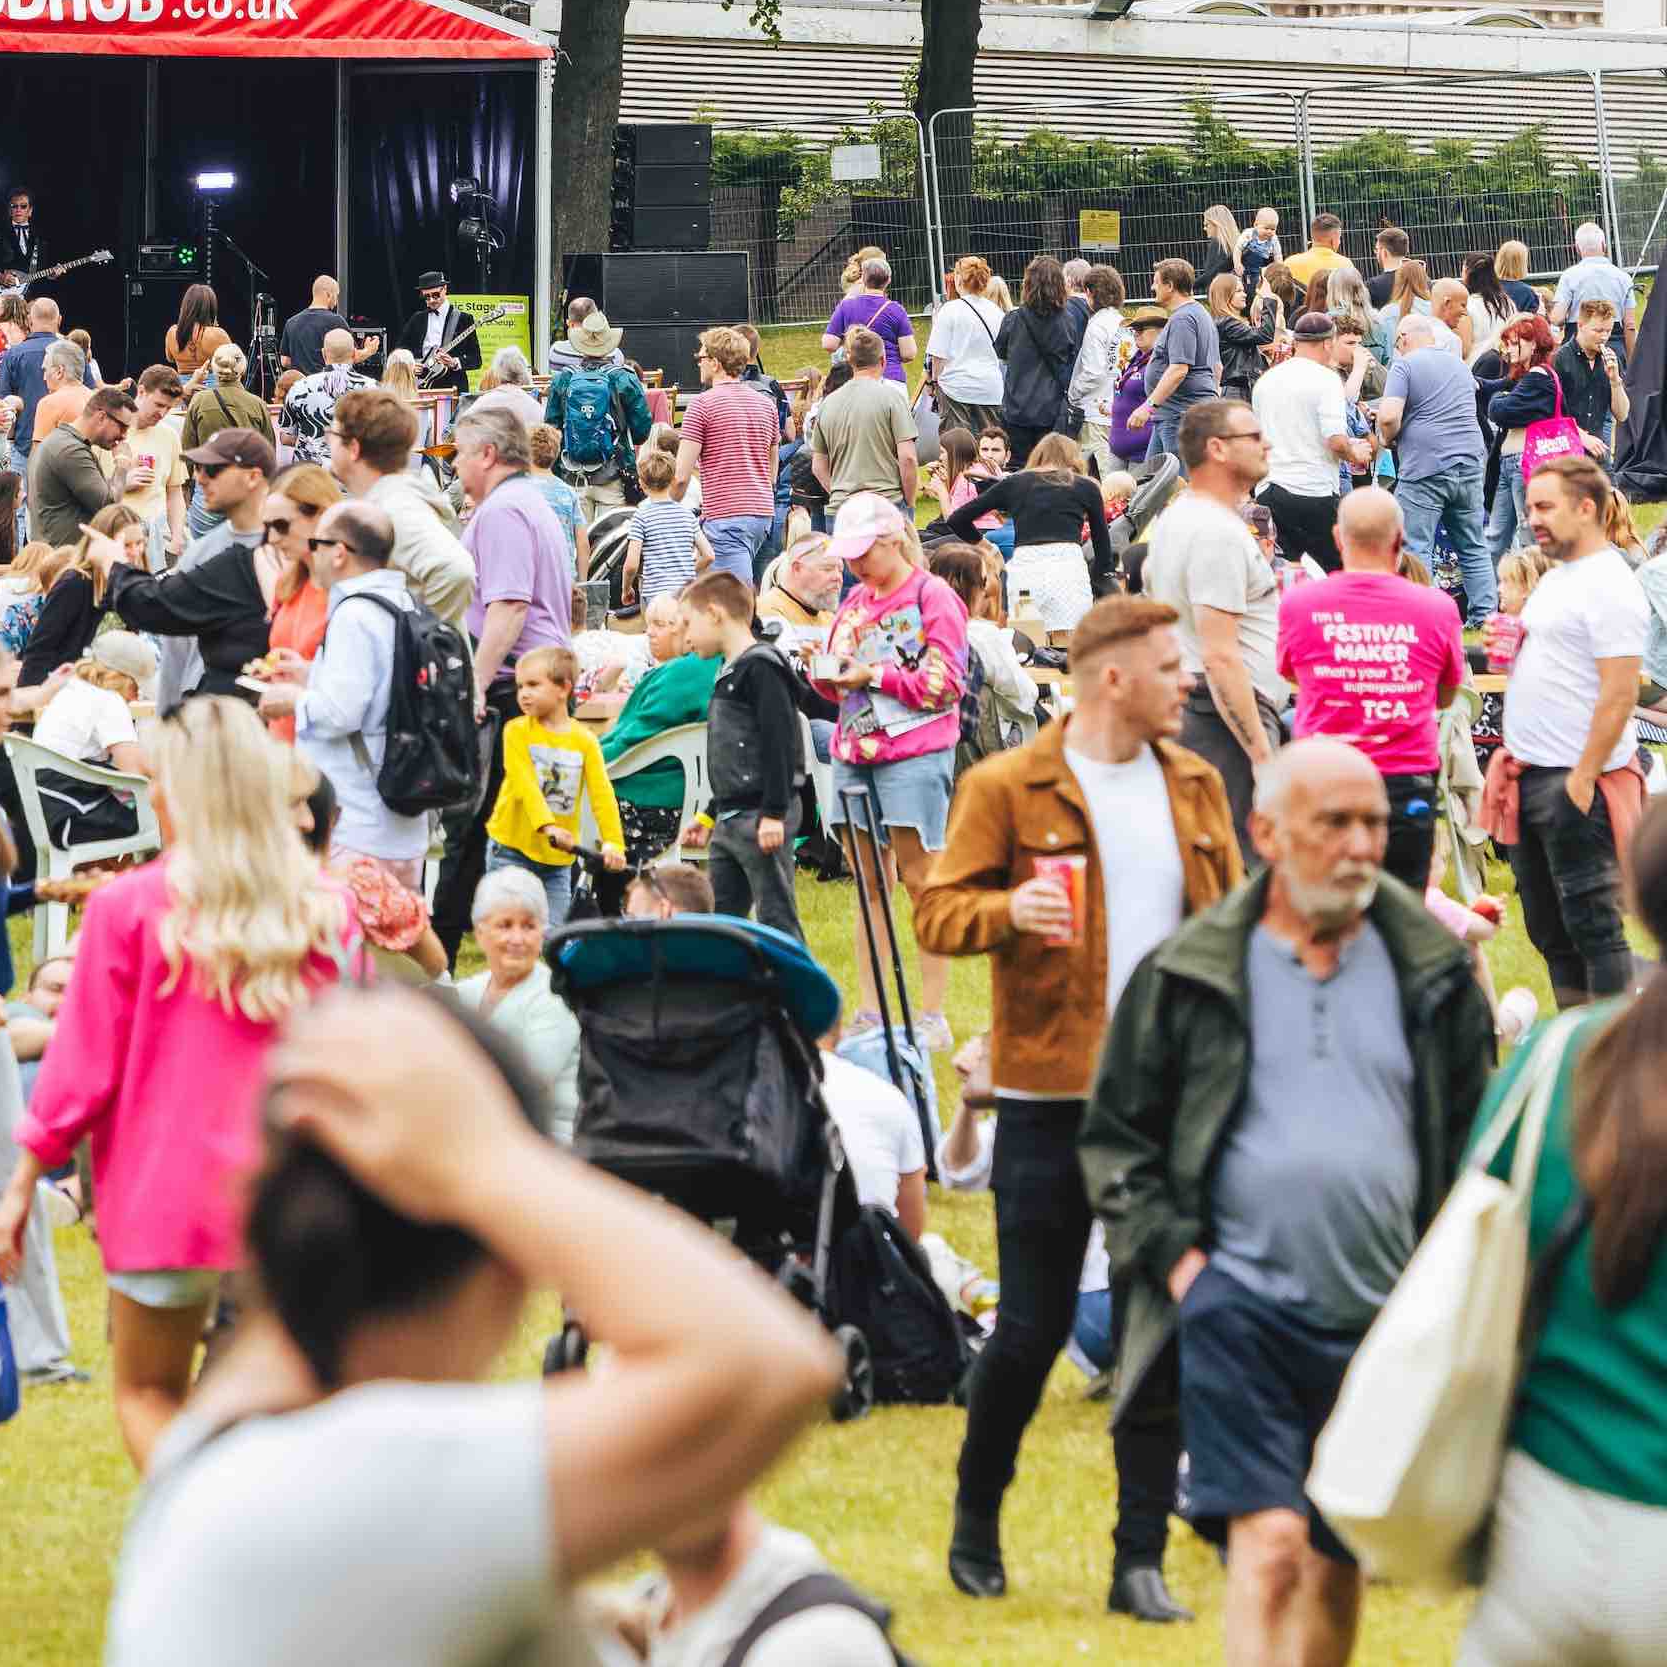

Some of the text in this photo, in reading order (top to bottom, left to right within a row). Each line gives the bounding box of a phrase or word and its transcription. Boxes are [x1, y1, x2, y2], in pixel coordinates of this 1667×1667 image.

[1323, 623, 1420, 644] FESTIVAL
[1334, 643, 1409, 662] MAKER
[1360, 699, 1410, 720] TCA
